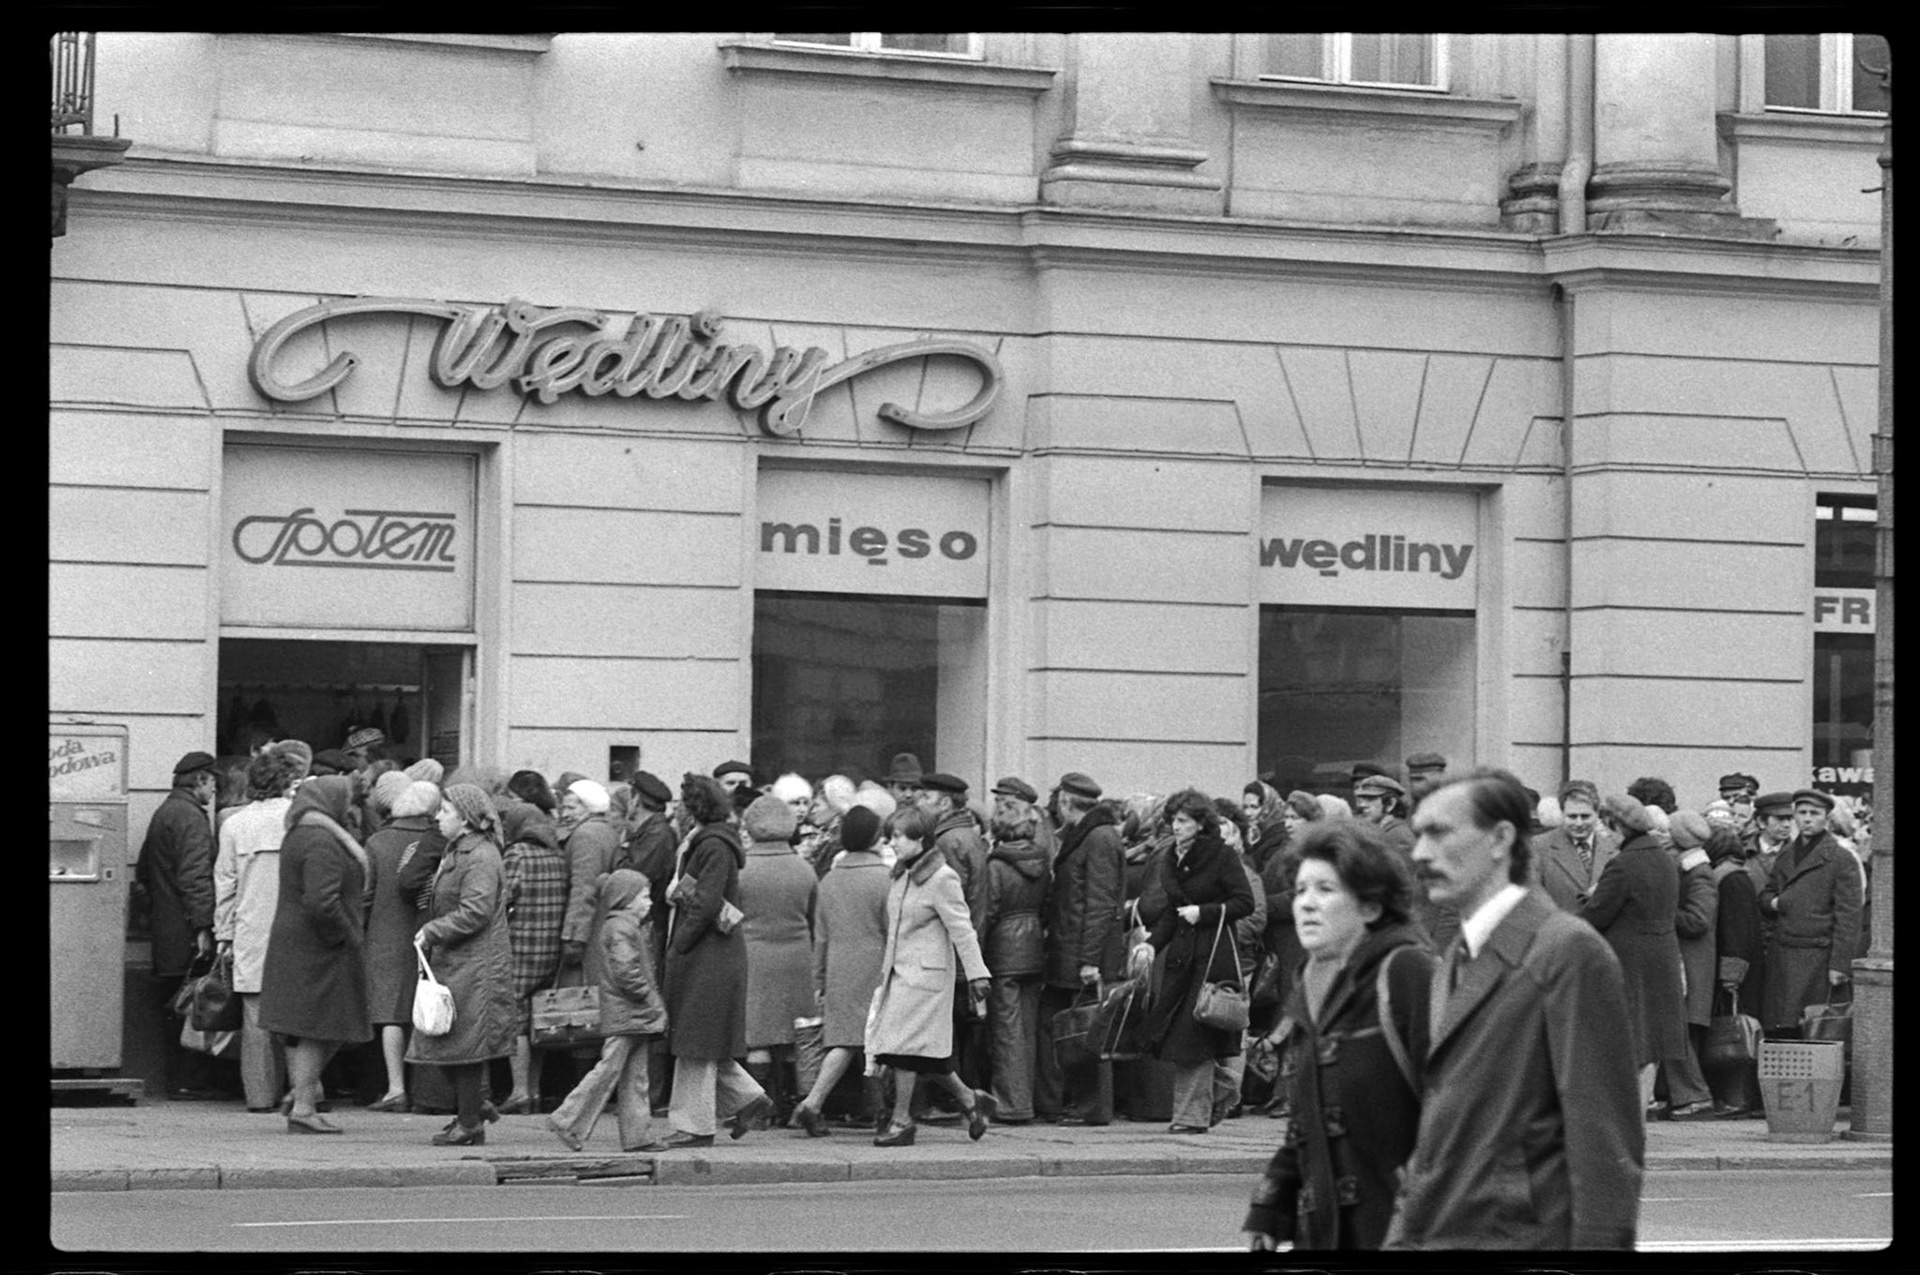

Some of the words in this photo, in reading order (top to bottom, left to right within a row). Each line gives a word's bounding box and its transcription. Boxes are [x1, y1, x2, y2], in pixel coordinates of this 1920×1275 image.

[247, 296, 1004, 437] Wędliny
[761, 517, 978, 566] mięso
[1259, 534, 1474, 580] wędliny
